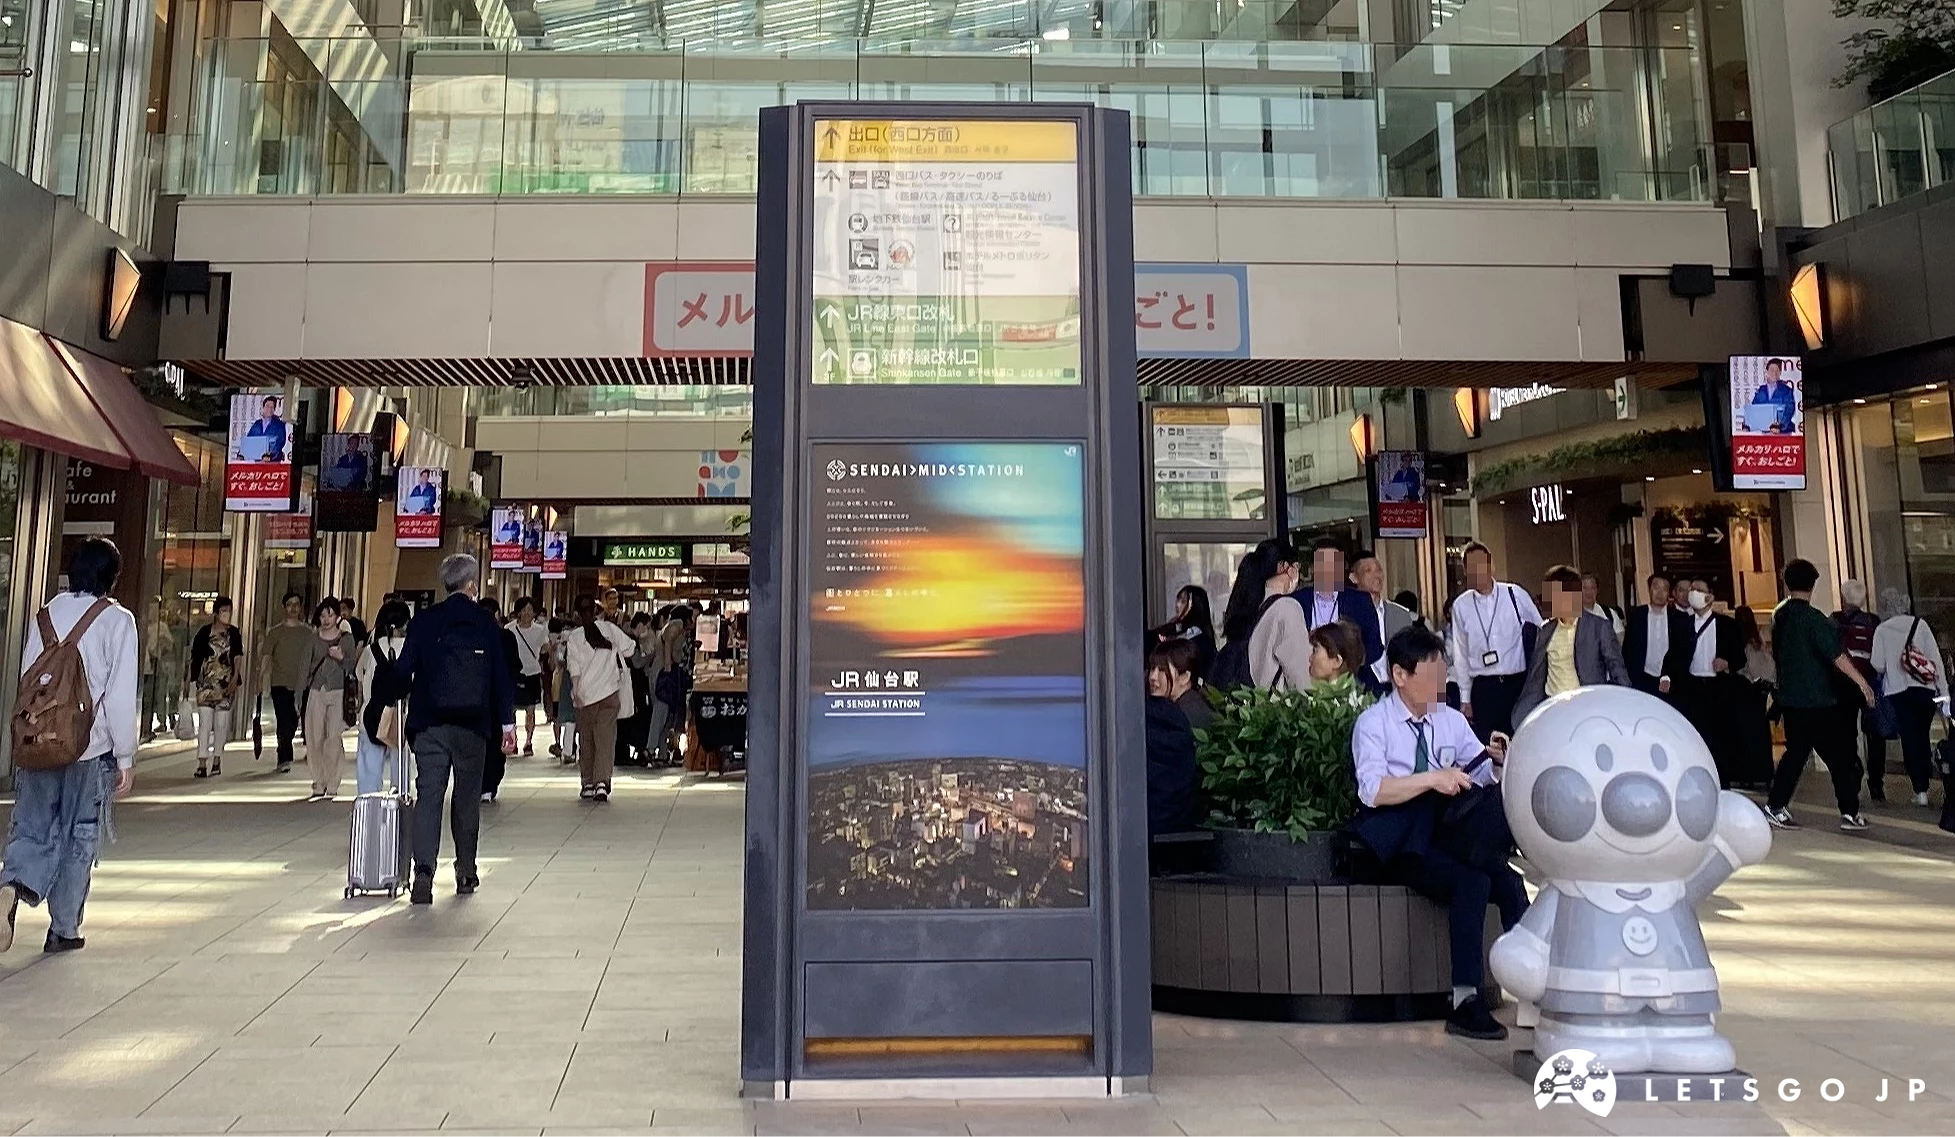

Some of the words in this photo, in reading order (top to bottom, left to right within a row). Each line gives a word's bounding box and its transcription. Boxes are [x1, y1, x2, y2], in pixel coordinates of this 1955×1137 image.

[849, 126, 961, 142] 出口(西口方面)
[849, 145, 866, 154] Exit
[1135, 291, 1215, 331] ごと!
[881, 347, 979, 366] 新幹線改札口
[1064, 446, 1077, 457] JR
[67, 480, 75, 491] &
[628, 546, 675, 557] HANDS
[831, 670, 919, 688] JR仙台駅
[831, 699, 844, 709] JR
[847, 699, 880, 709] SENDAI
[883, 699, 921, 709] STATION
